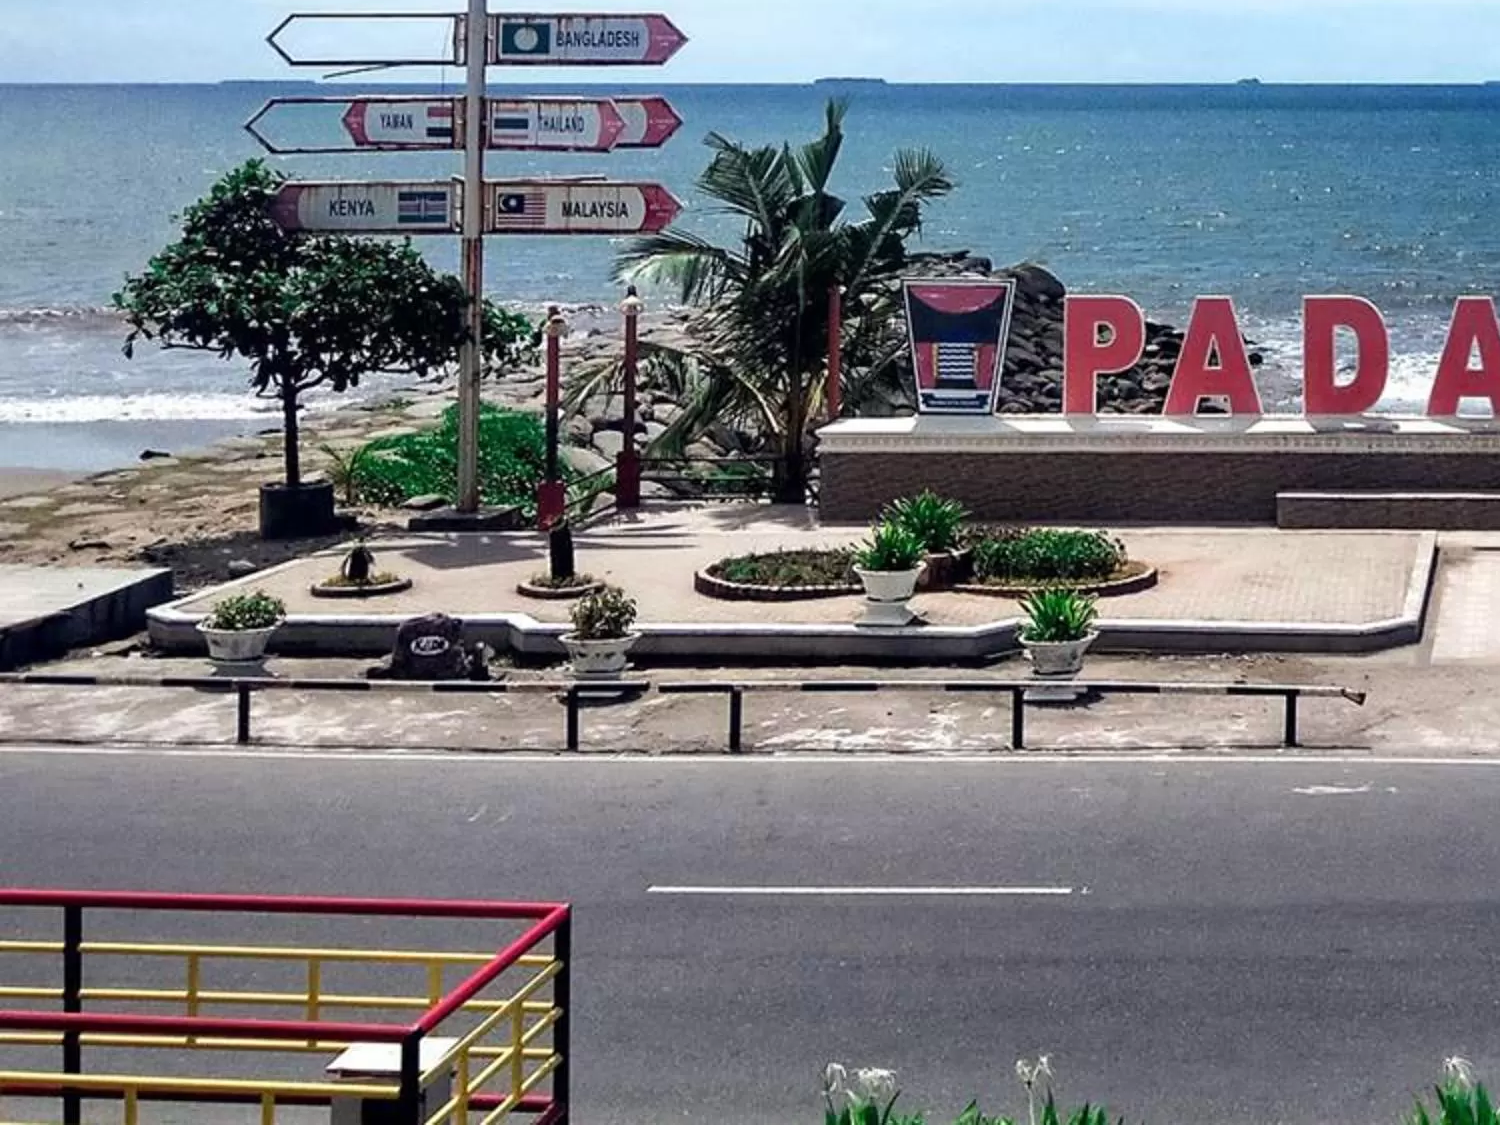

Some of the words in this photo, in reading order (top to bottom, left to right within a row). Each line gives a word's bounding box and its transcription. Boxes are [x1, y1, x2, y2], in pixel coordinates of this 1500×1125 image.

[556, 30, 640, 48] BANGLADESH
[537, 114, 585, 133] THAILAND
[328, 198, 375, 216] KENYA
[561, 200, 629, 218] MALAYSIA
